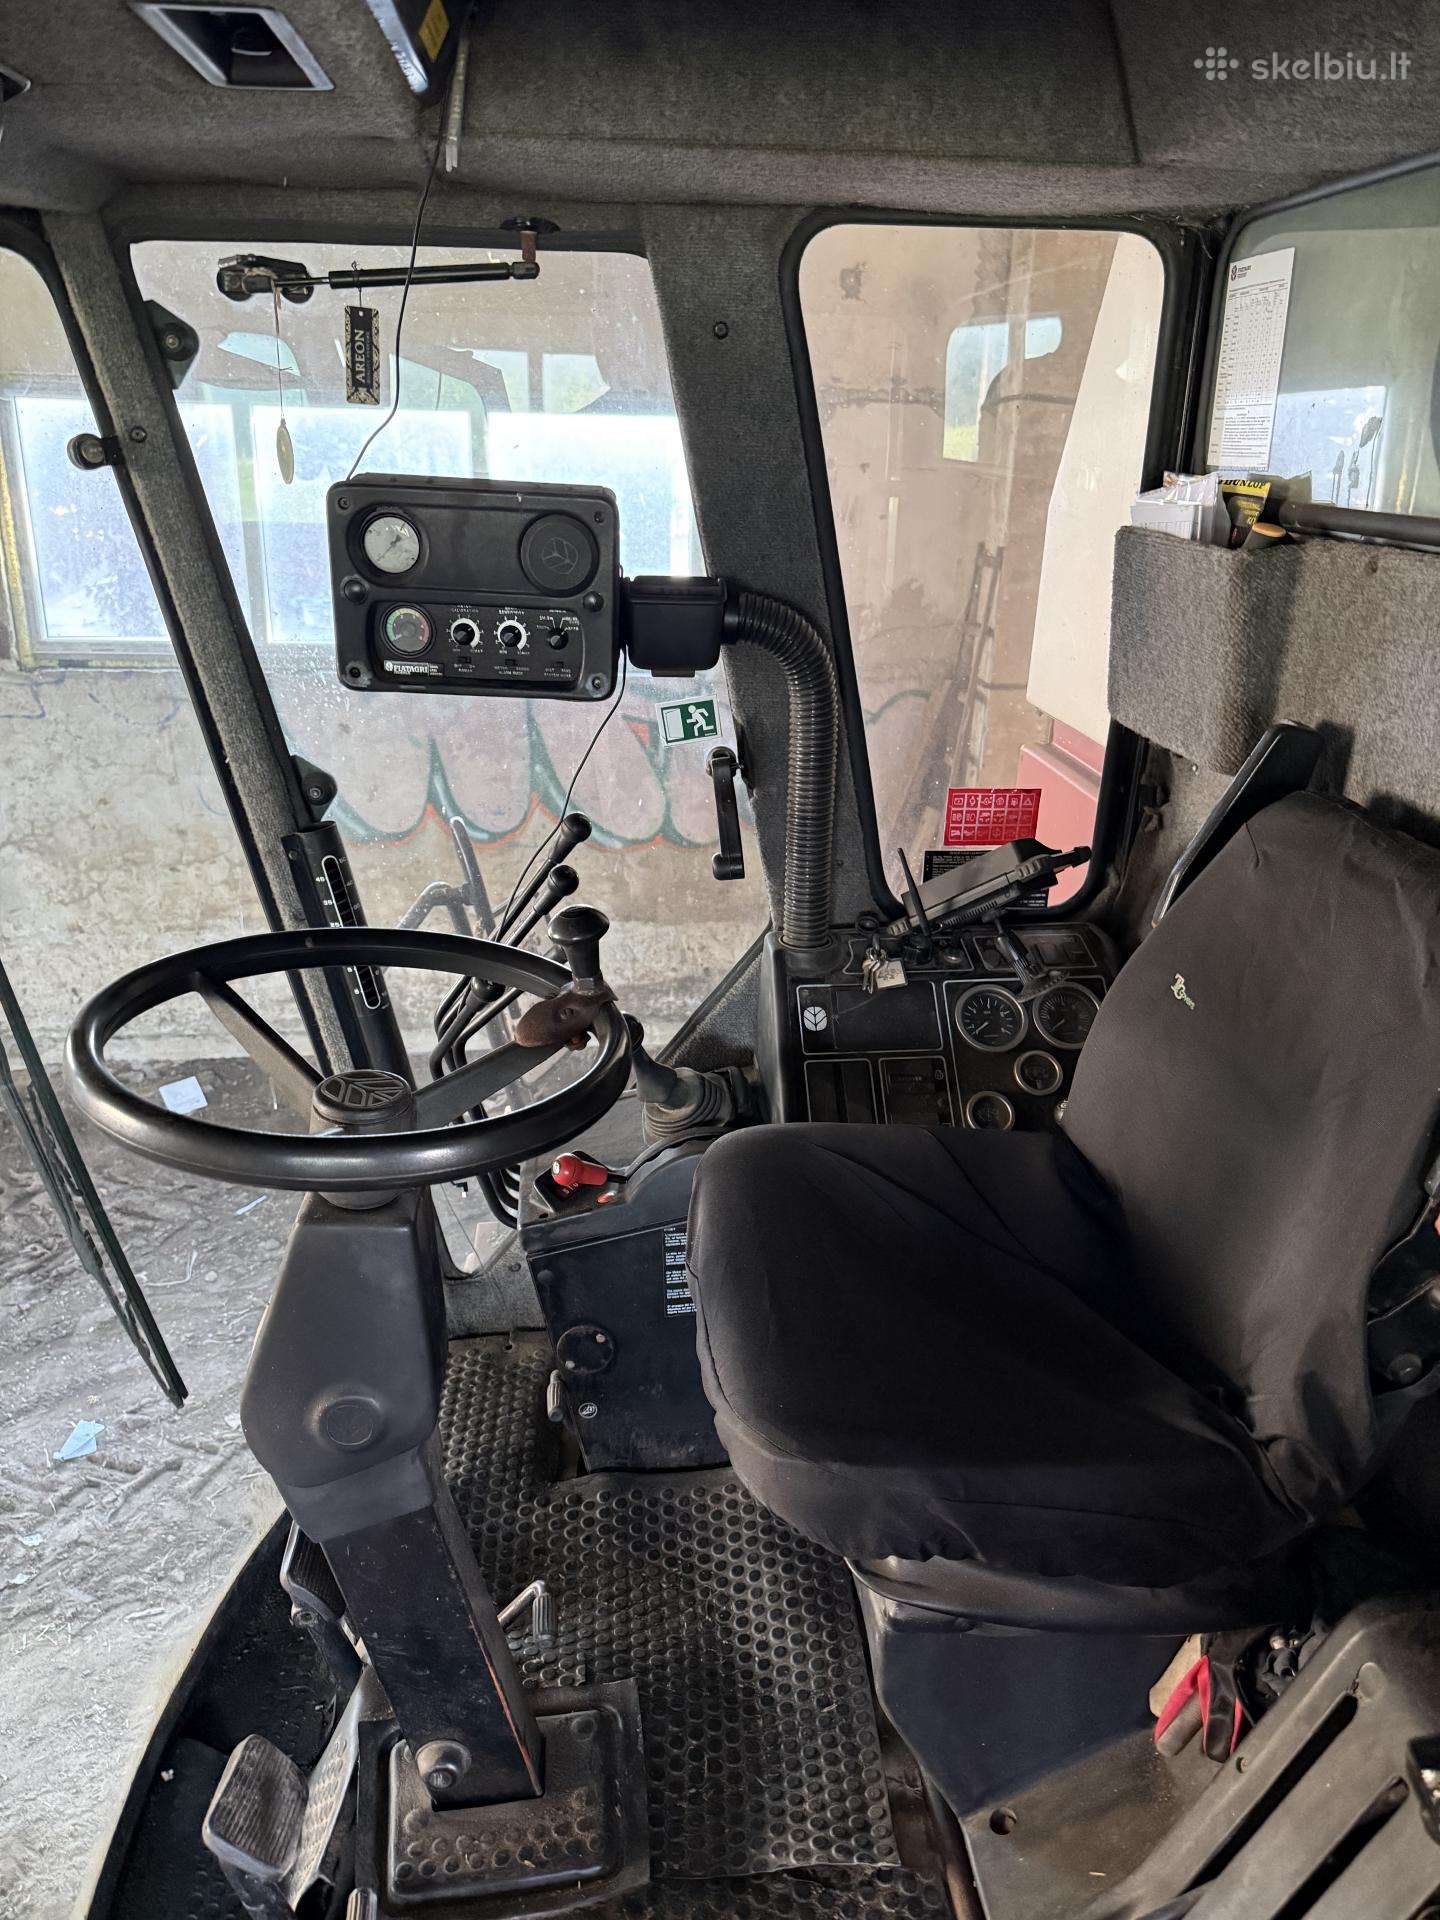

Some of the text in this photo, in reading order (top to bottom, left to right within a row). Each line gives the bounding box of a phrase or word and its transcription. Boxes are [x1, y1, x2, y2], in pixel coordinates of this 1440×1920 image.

[355, 329, 365, 384] AREON
[1224, 480, 1266, 489] DUNLOP
[394, 665, 428, 673] FIATAGRI
